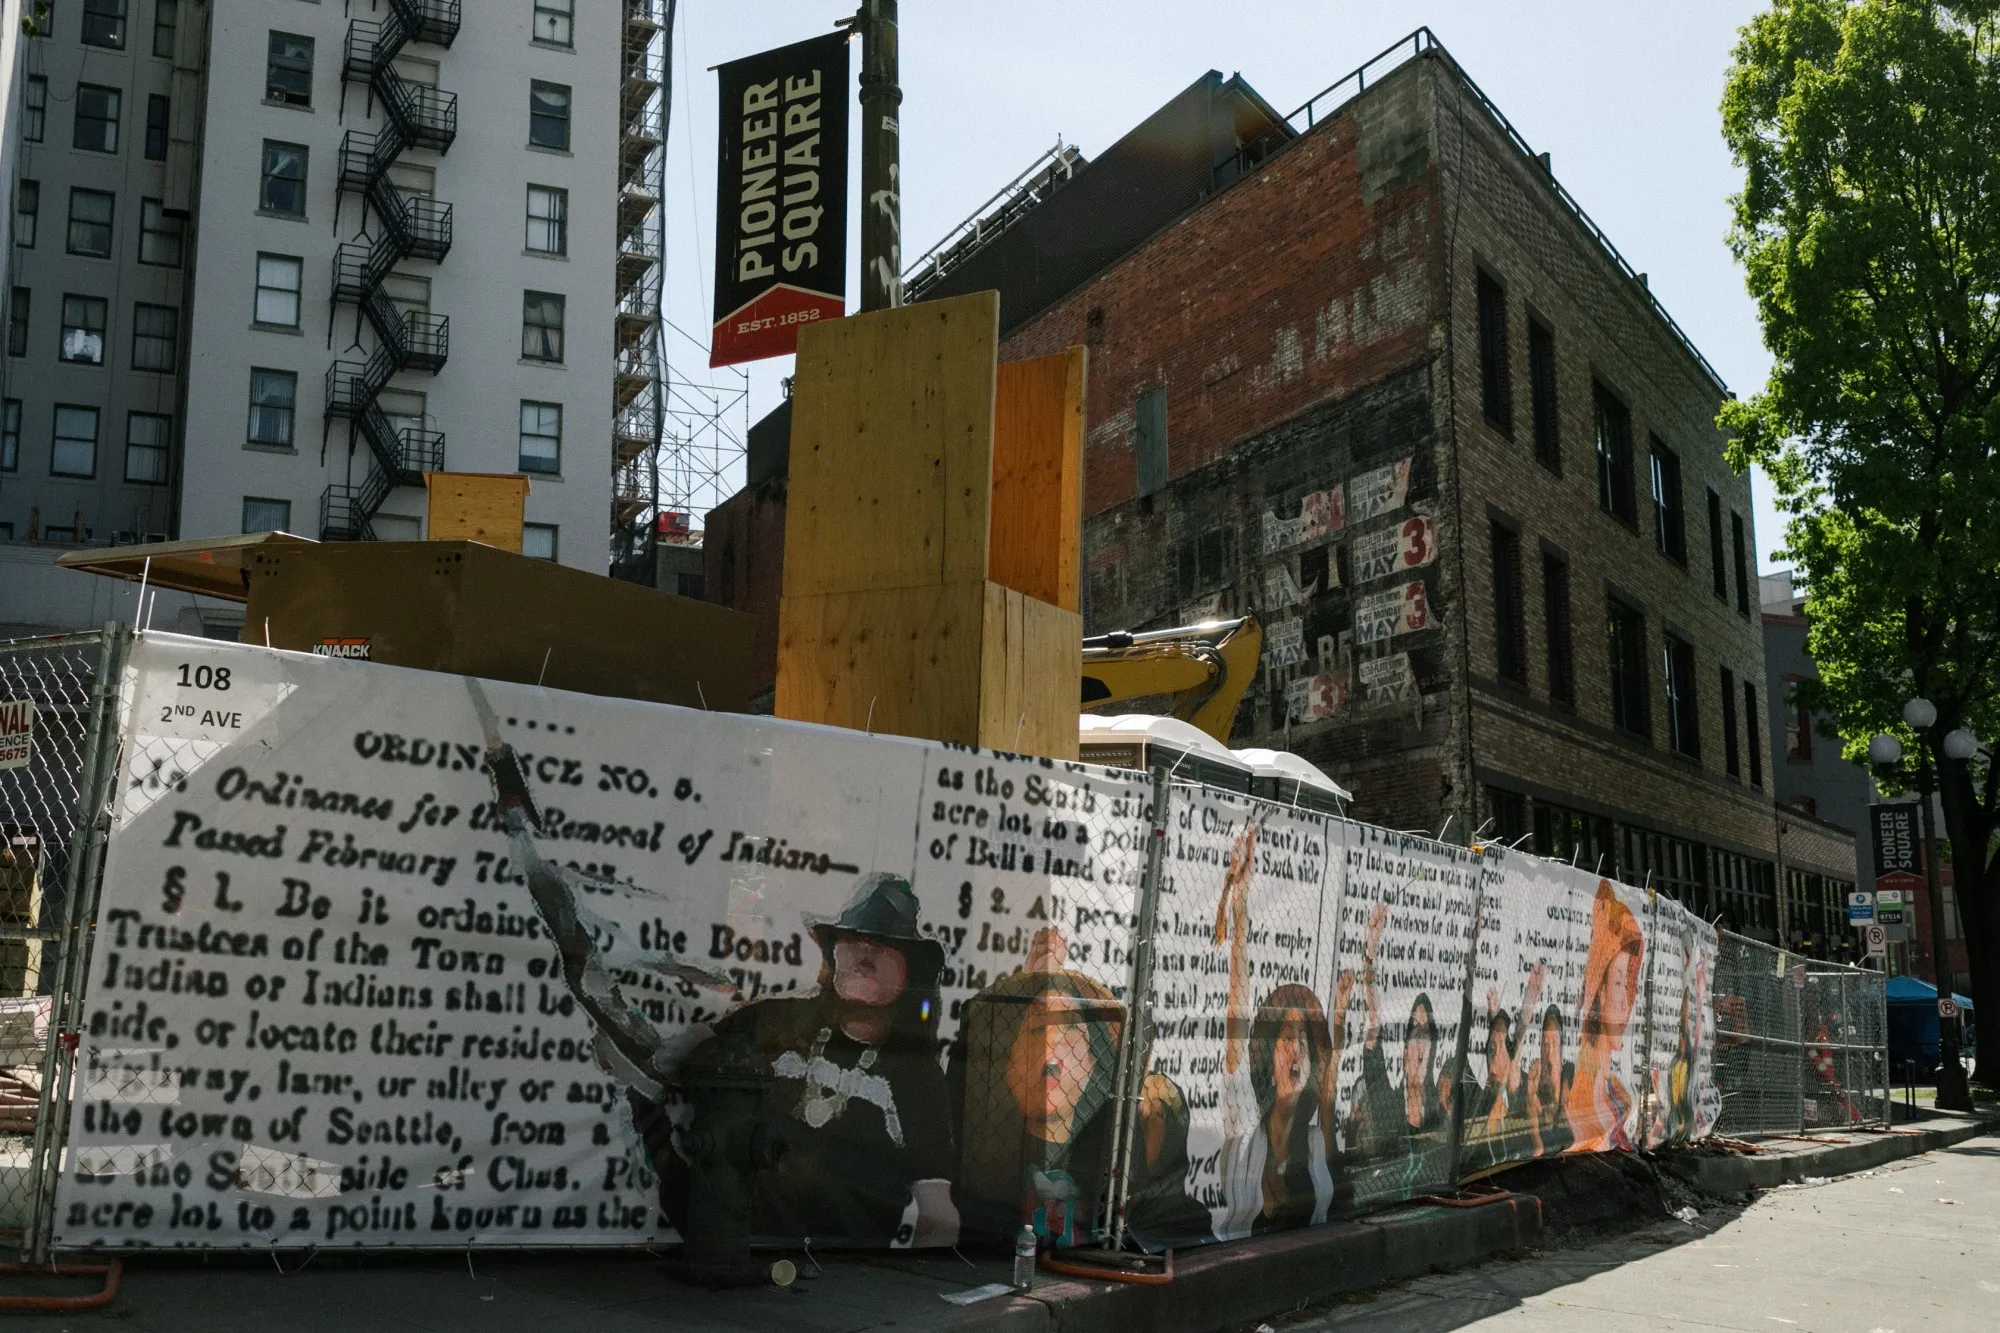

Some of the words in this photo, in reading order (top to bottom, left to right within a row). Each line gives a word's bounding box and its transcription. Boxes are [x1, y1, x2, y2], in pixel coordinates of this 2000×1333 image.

[739, 77, 778, 283] PIONEER
[782, 69, 824, 273] SQUARE
[737, 317, 777, 334] EST.
[779, 308, 820, 326] 1852
[1403, 518, 1427, 566] 3
[1406, 581, 1427, 629] 3
[1358, 616, 1400, 642] MAY
[313, 644, 370, 658] KNAACK
[176, 663, 232, 692] 108
[200, 710, 242, 730] AVE
[469, 800, 510, 835] th
[677, 828, 715, 866] of
[1880, 812, 1897, 869] PIONEER
[1895, 811, 1912, 869] SQUARE
[283, 928, 323, 961] of
[335, 930, 389, 966] the
[639, 917, 688, 954] the
[709, 923, 803, 967] Board
[977, 921, 1030, 956] Indi
[245, 974, 286, 1002] or
[445, 980, 526, 1015] shall
[195, 1017, 236, 1049] or
[370, 1018, 453, 1058] their
[461, 1025, 597, 1064] residenc
[519, 1079, 557, 1103] or
[490, 1111, 566, 1147] from
[596, 1194, 649, 1230] the
